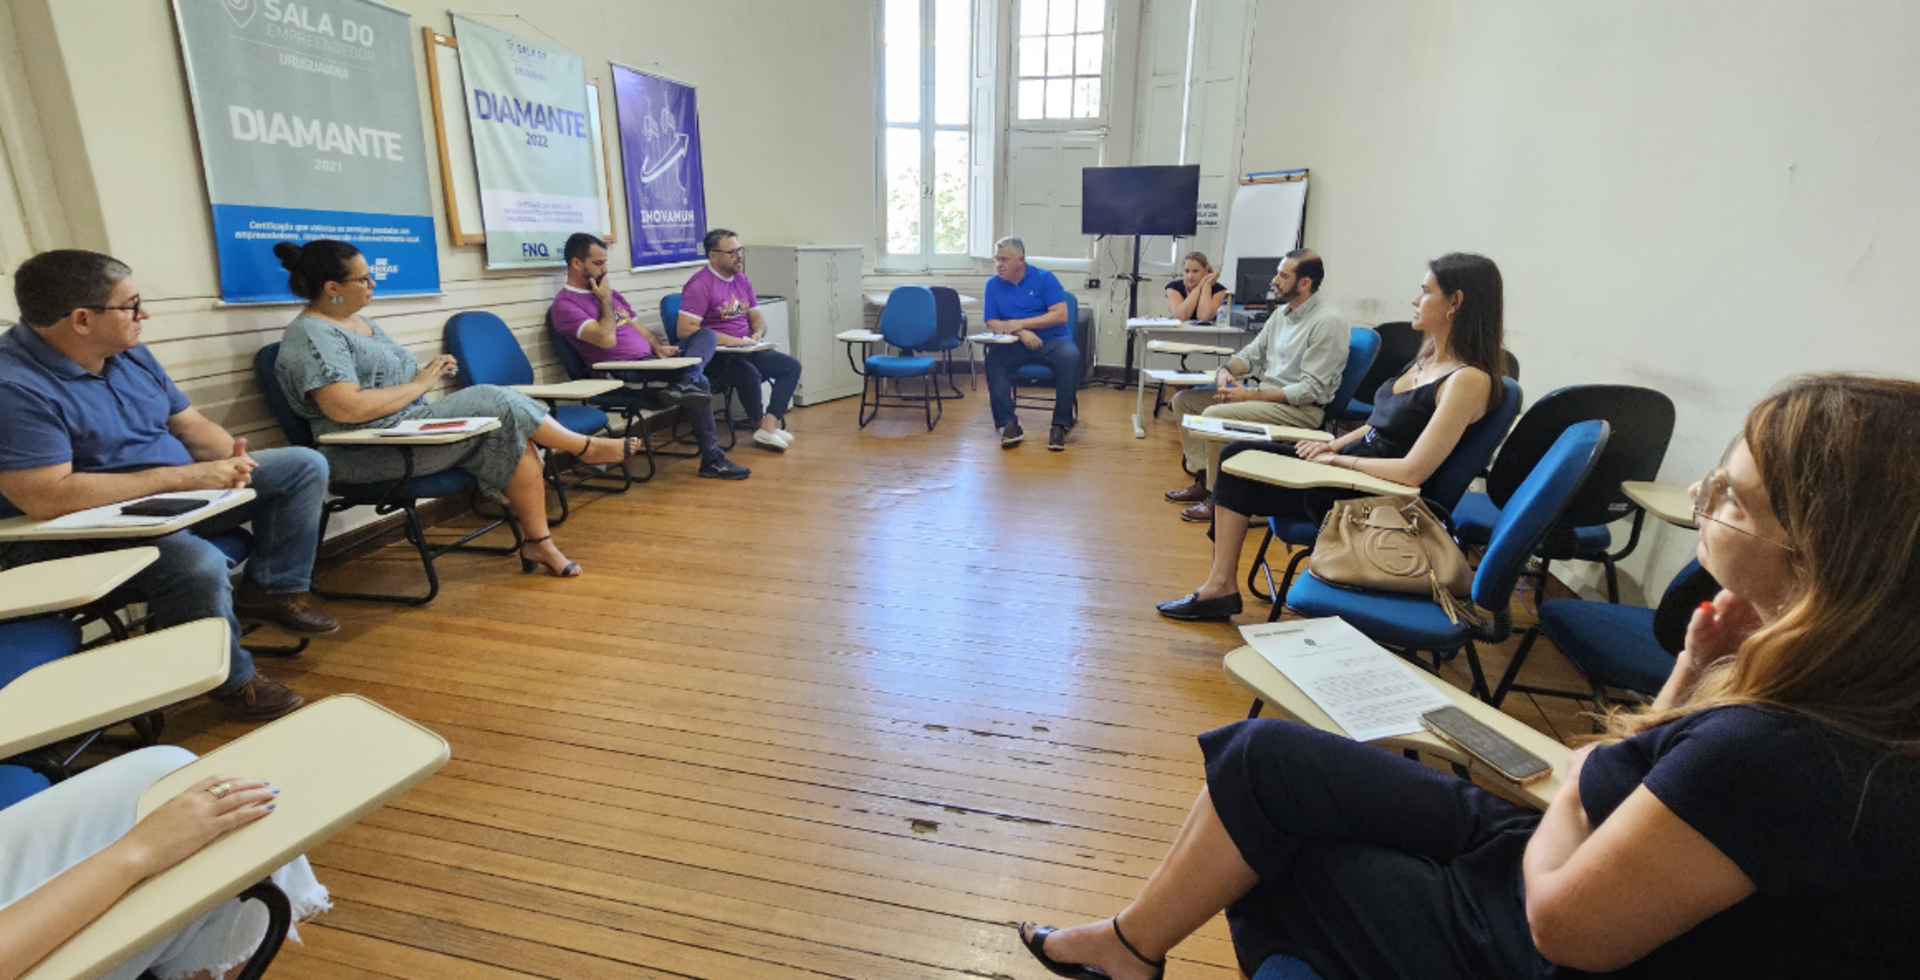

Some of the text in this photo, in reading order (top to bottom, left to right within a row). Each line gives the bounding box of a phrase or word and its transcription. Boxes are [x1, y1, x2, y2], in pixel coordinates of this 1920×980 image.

[263, 0, 375, 47] SALA DO
[267, 24, 376, 63] EMPREENDEDOR
[279, 52, 349, 80] URUGUAIANA
[473, 88, 587, 139] DIAMANTE
[228, 104, 404, 161] DIAMANTE
[525, 132, 549, 148] 2022
[314, 159, 343, 173] 2021
[641, 210, 695, 223] INOVAMUN
[521, 242, 550, 258] FNQ
